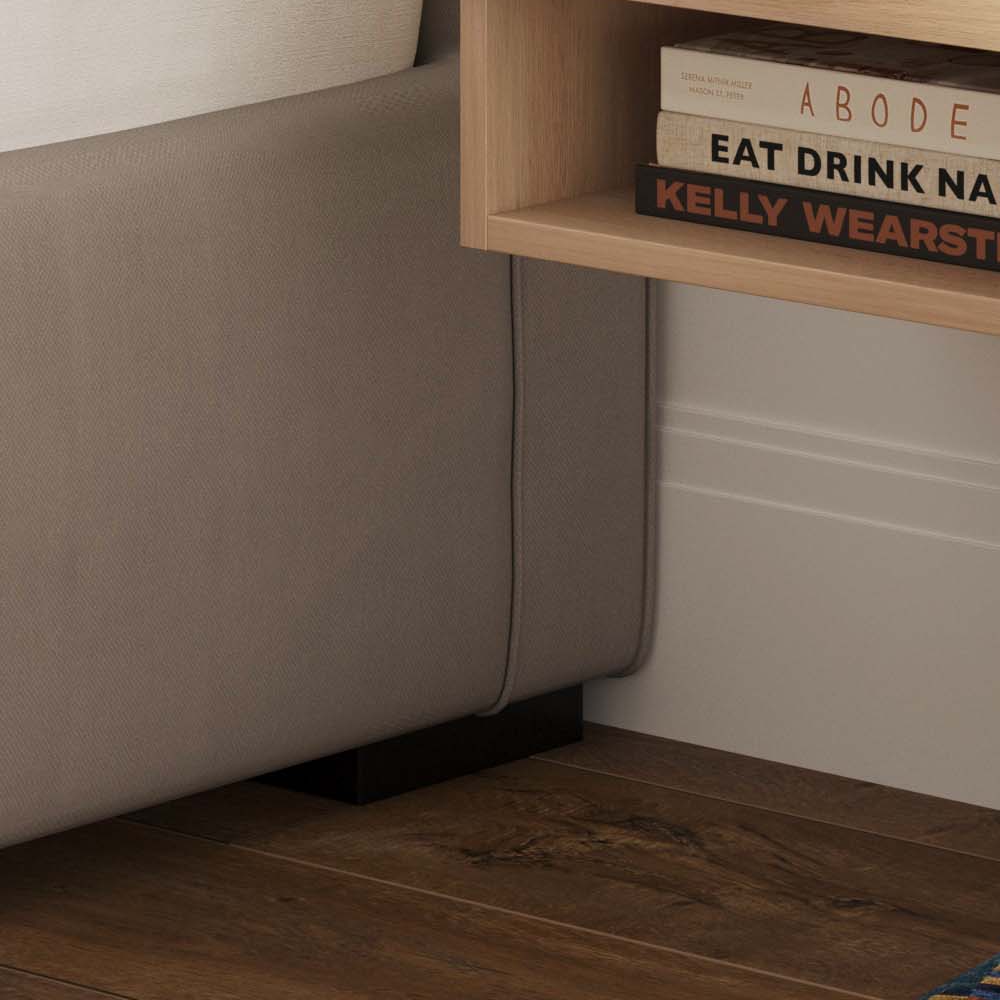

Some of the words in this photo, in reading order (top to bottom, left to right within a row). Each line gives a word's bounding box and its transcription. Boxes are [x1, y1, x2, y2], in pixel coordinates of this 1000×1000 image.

[800, 82, 970, 141] ABODE
[711, 133, 784, 171] EAT
[797, 146, 925, 195] DRINK
[655, 179, 789, 227] KELLY
